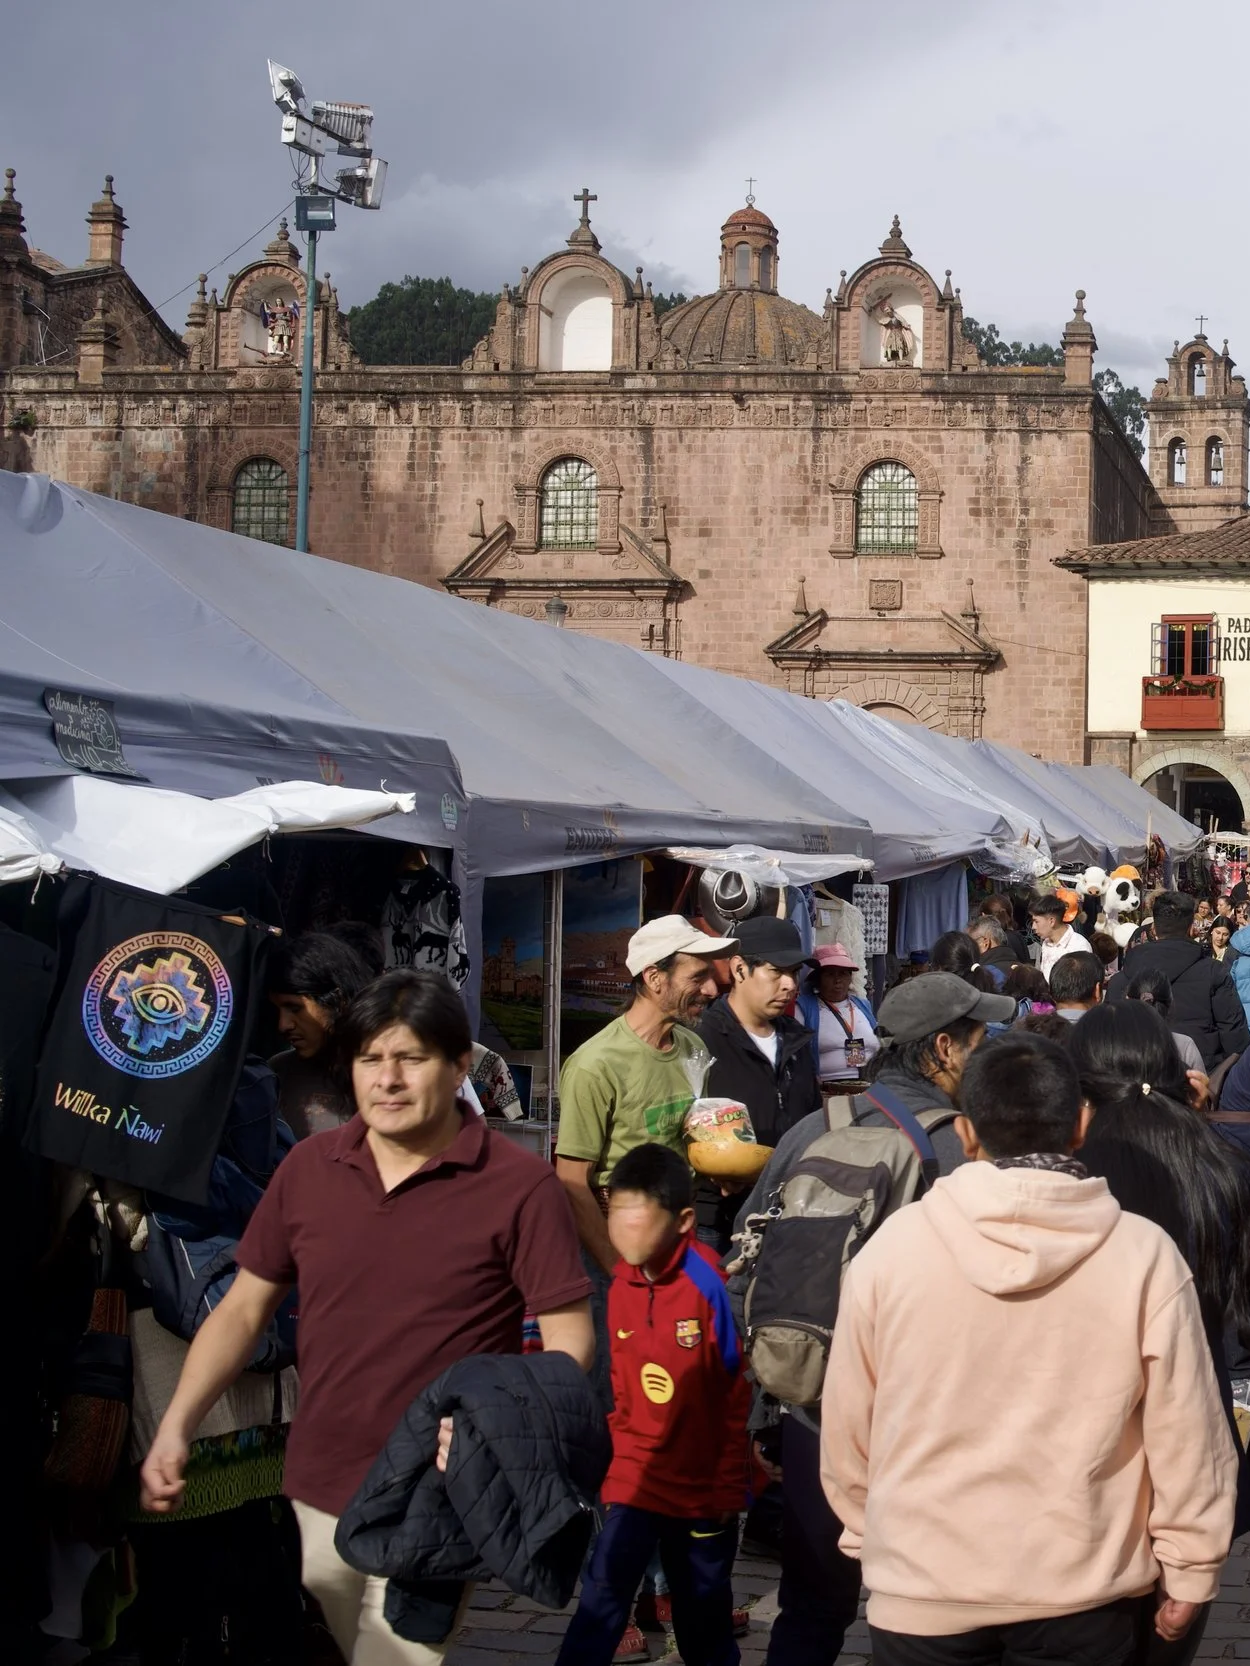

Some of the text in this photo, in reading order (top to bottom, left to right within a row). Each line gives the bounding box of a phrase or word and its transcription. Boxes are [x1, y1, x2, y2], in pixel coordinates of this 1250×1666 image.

[48, 691, 88, 715] alimento
[55, 722, 93, 743] medicina
[54, 1082, 165, 1145] Willka Ñawi
